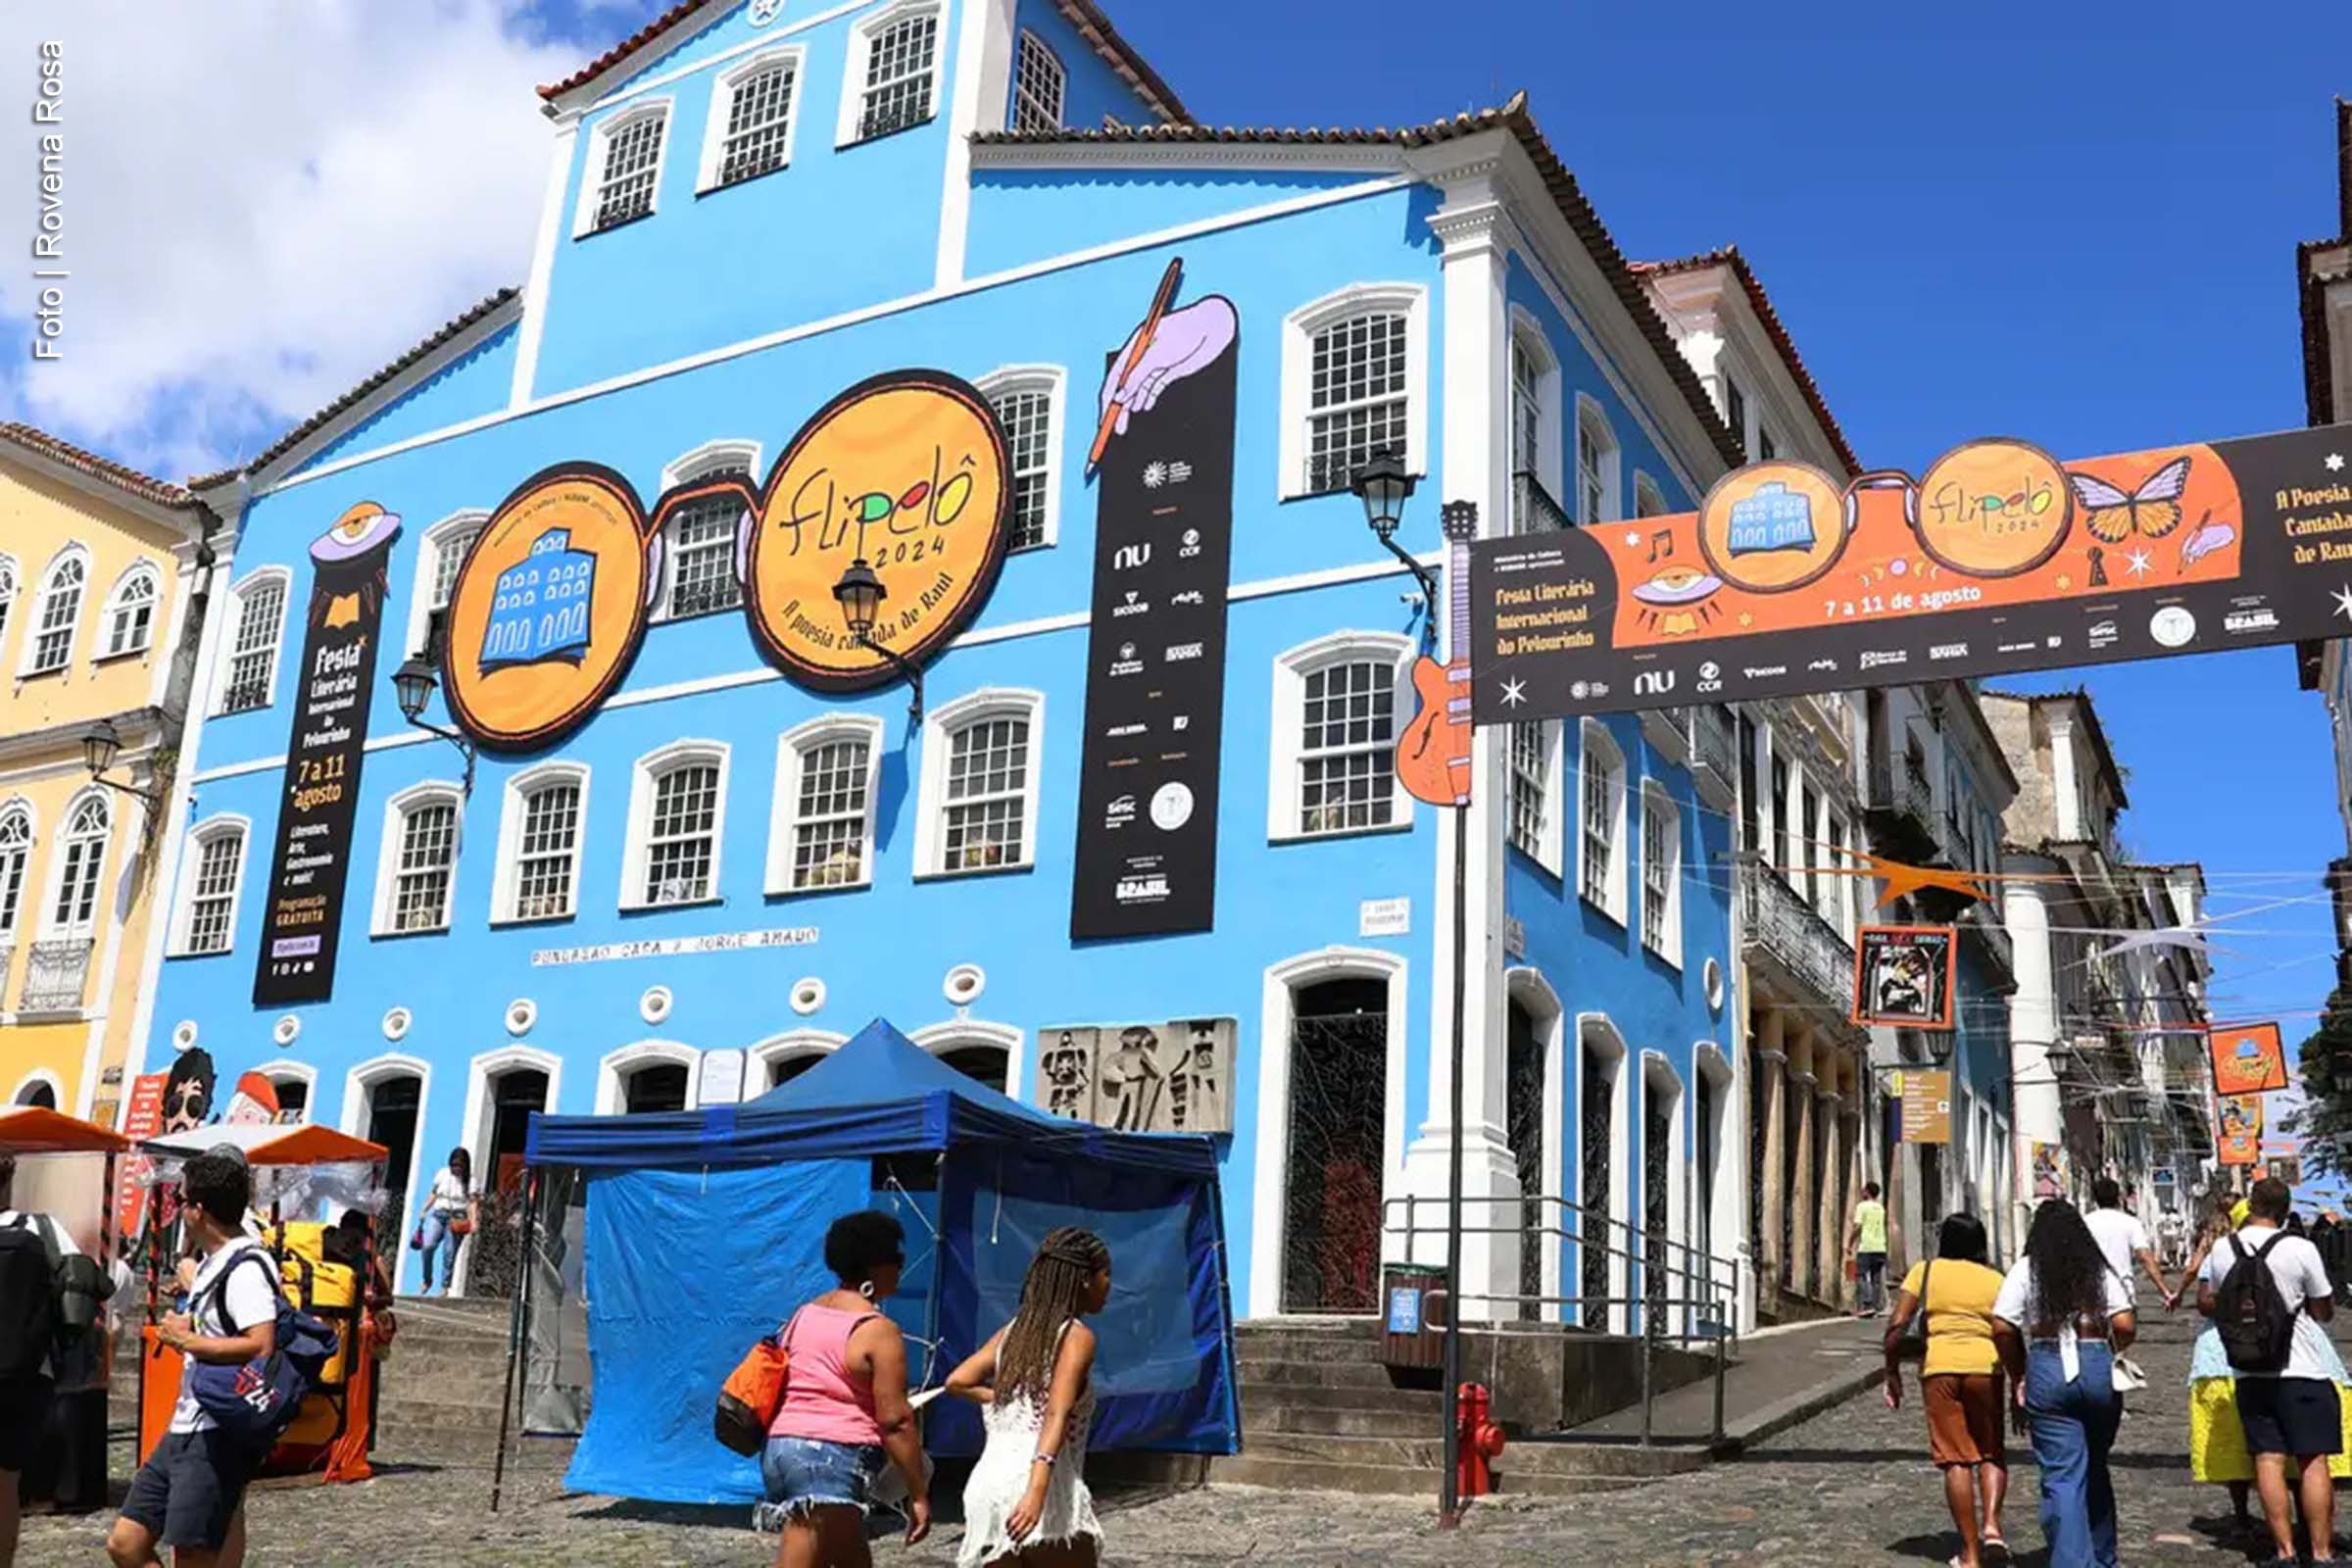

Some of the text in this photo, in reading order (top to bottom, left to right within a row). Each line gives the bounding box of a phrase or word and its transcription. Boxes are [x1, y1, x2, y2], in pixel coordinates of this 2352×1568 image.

[2291, 482, 2351, 508] Poesia
[875, 536, 945, 569] 2024
[2294, 543, 2317, 564] de
[1495, 578, 1594, 606] Festa Literária
[1825, 586, 1982, 617] 7 a 11 de agosto
[789, 612, 835, 649] poesia
[901, 609, 920, 630] de
[918, 571, 954, 612] Raul
[1495, 604, 1588, 630] Internacional
[2224, 612, 2279, 630] BRASIL
[1496, 630, 1594, 656] do Pelourinho
[314, 643, 360, 677] Festa
[311, 672, 358, 699] Literária
[299, 754, 345, 783] 7 a 11
[294, 783, 342, 812] agosto
[1115, 879, 1171, 900] BRASIL
